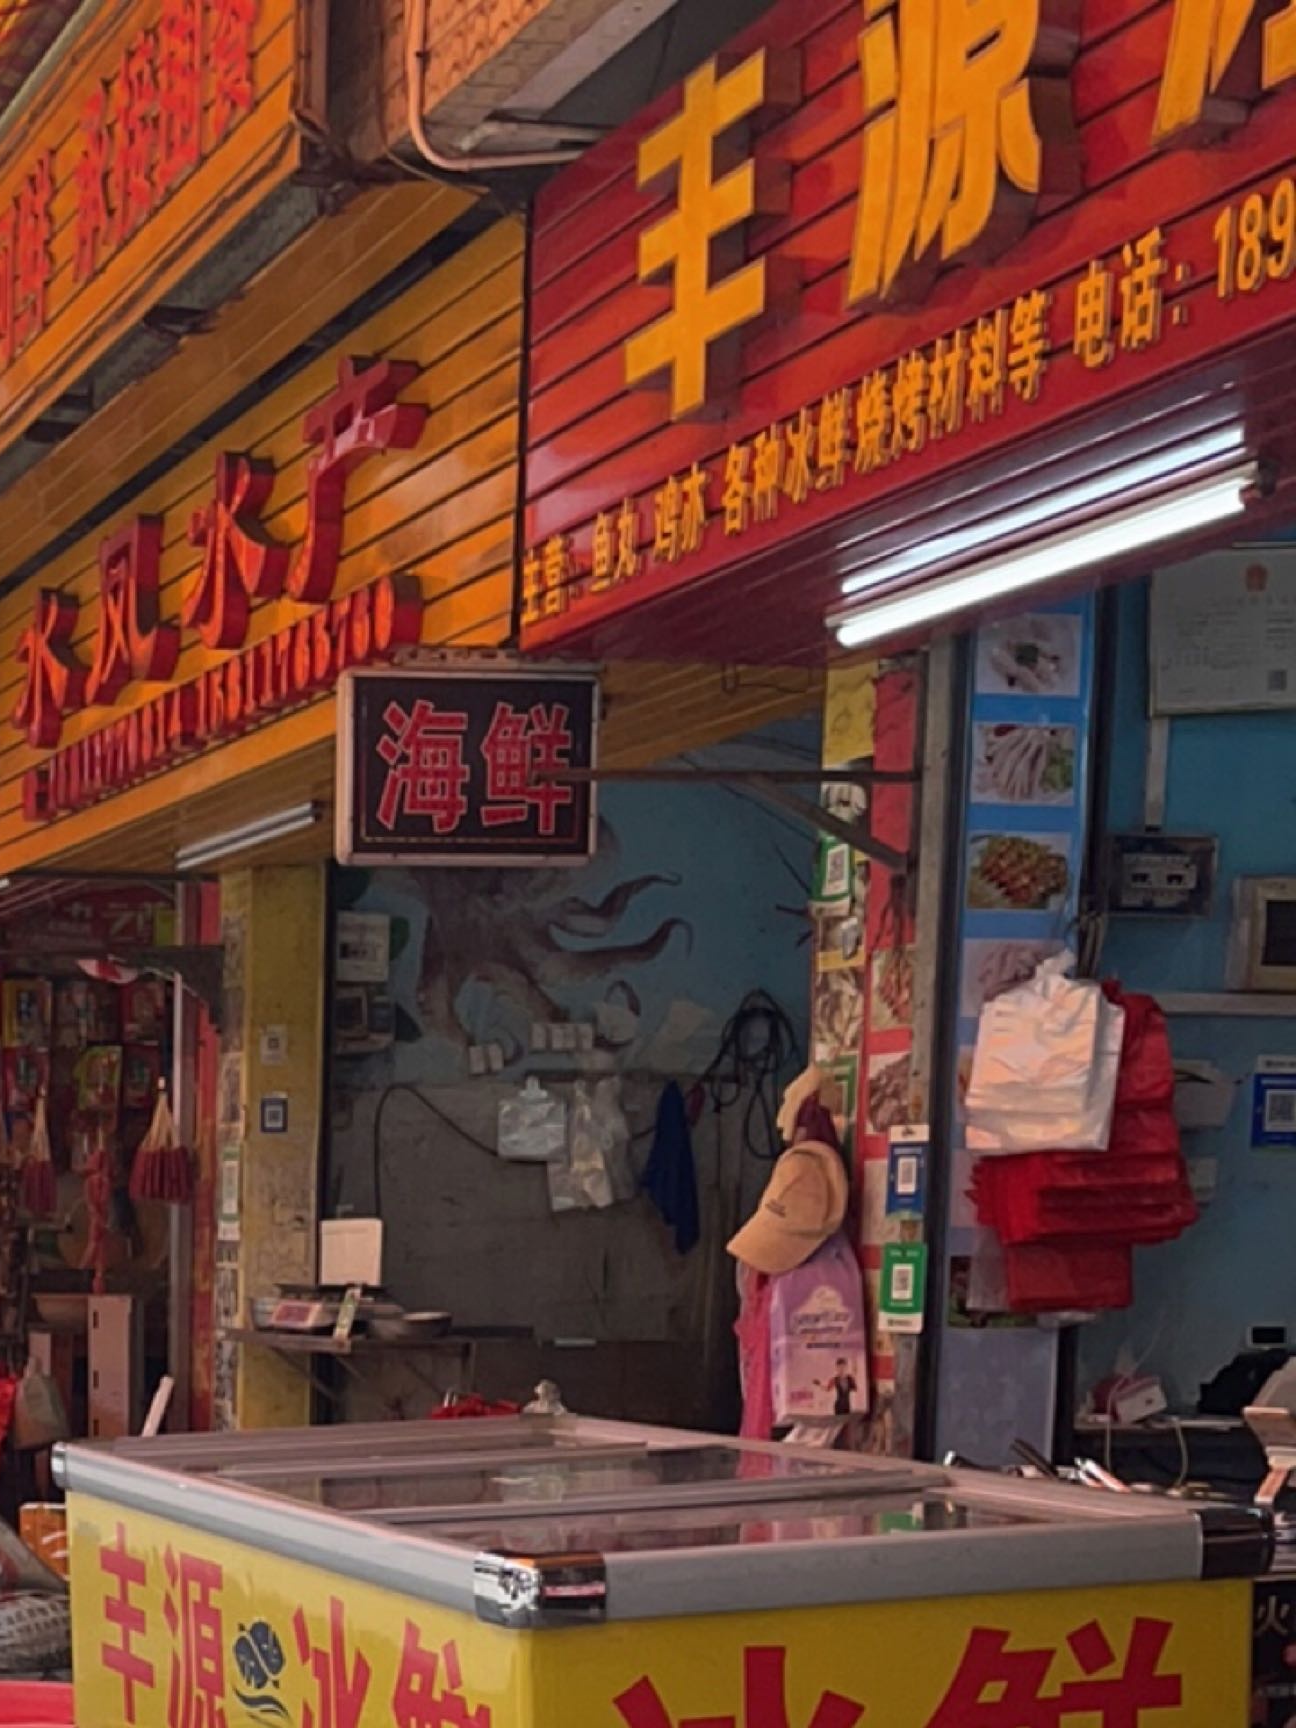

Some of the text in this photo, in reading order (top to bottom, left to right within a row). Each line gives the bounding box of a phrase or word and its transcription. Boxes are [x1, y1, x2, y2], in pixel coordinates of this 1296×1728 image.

[590, 497, 638, 592] 鱼丸
[1214, 178, 1296, 299] 189
[376, 699, 573, 836] 海鲜
